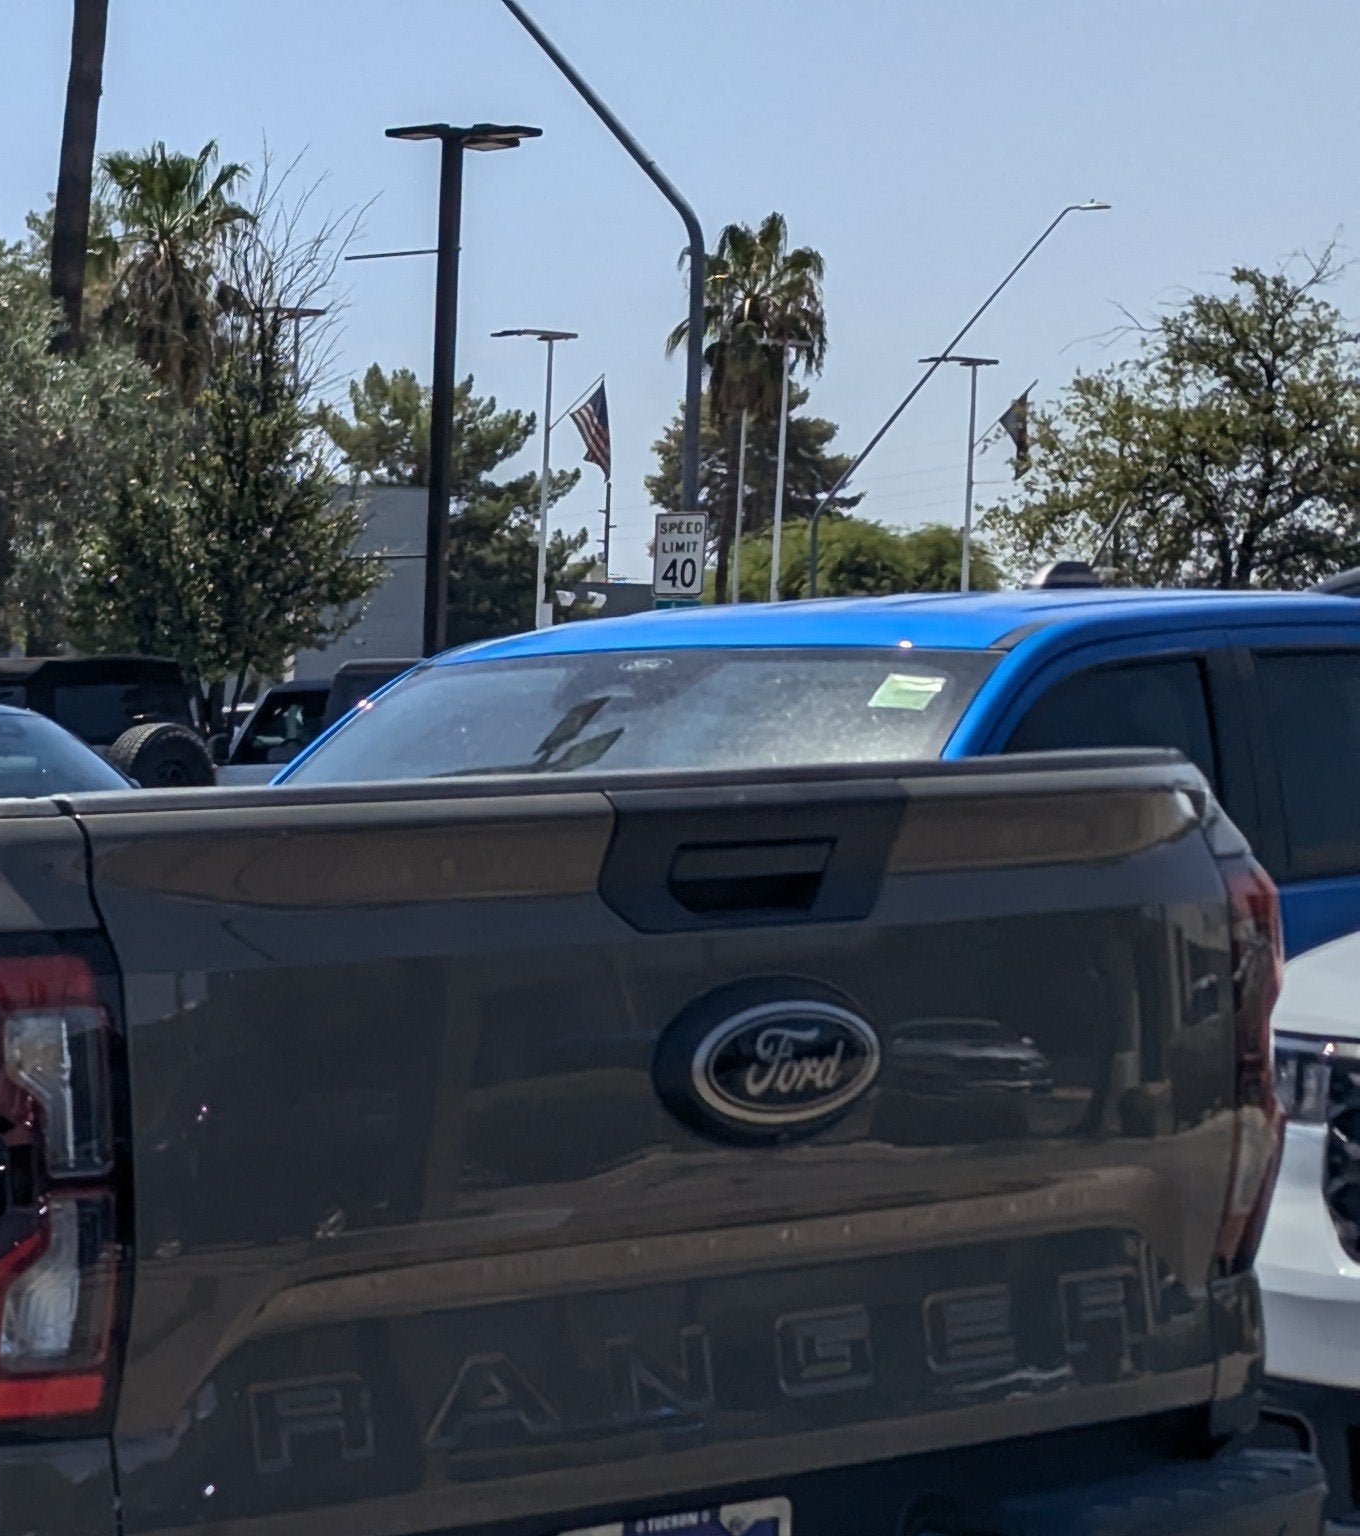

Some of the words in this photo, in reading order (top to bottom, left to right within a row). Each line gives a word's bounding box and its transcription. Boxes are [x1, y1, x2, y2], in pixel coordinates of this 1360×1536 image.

[660, 522, 703, 535] SPEED
[662, 541, 698, 554] LIMIT
[661, 558, 697, 589] 40
[745, 1027, 845, 1096] Ford
[249, 1265, 1140, 1473] RANGER
